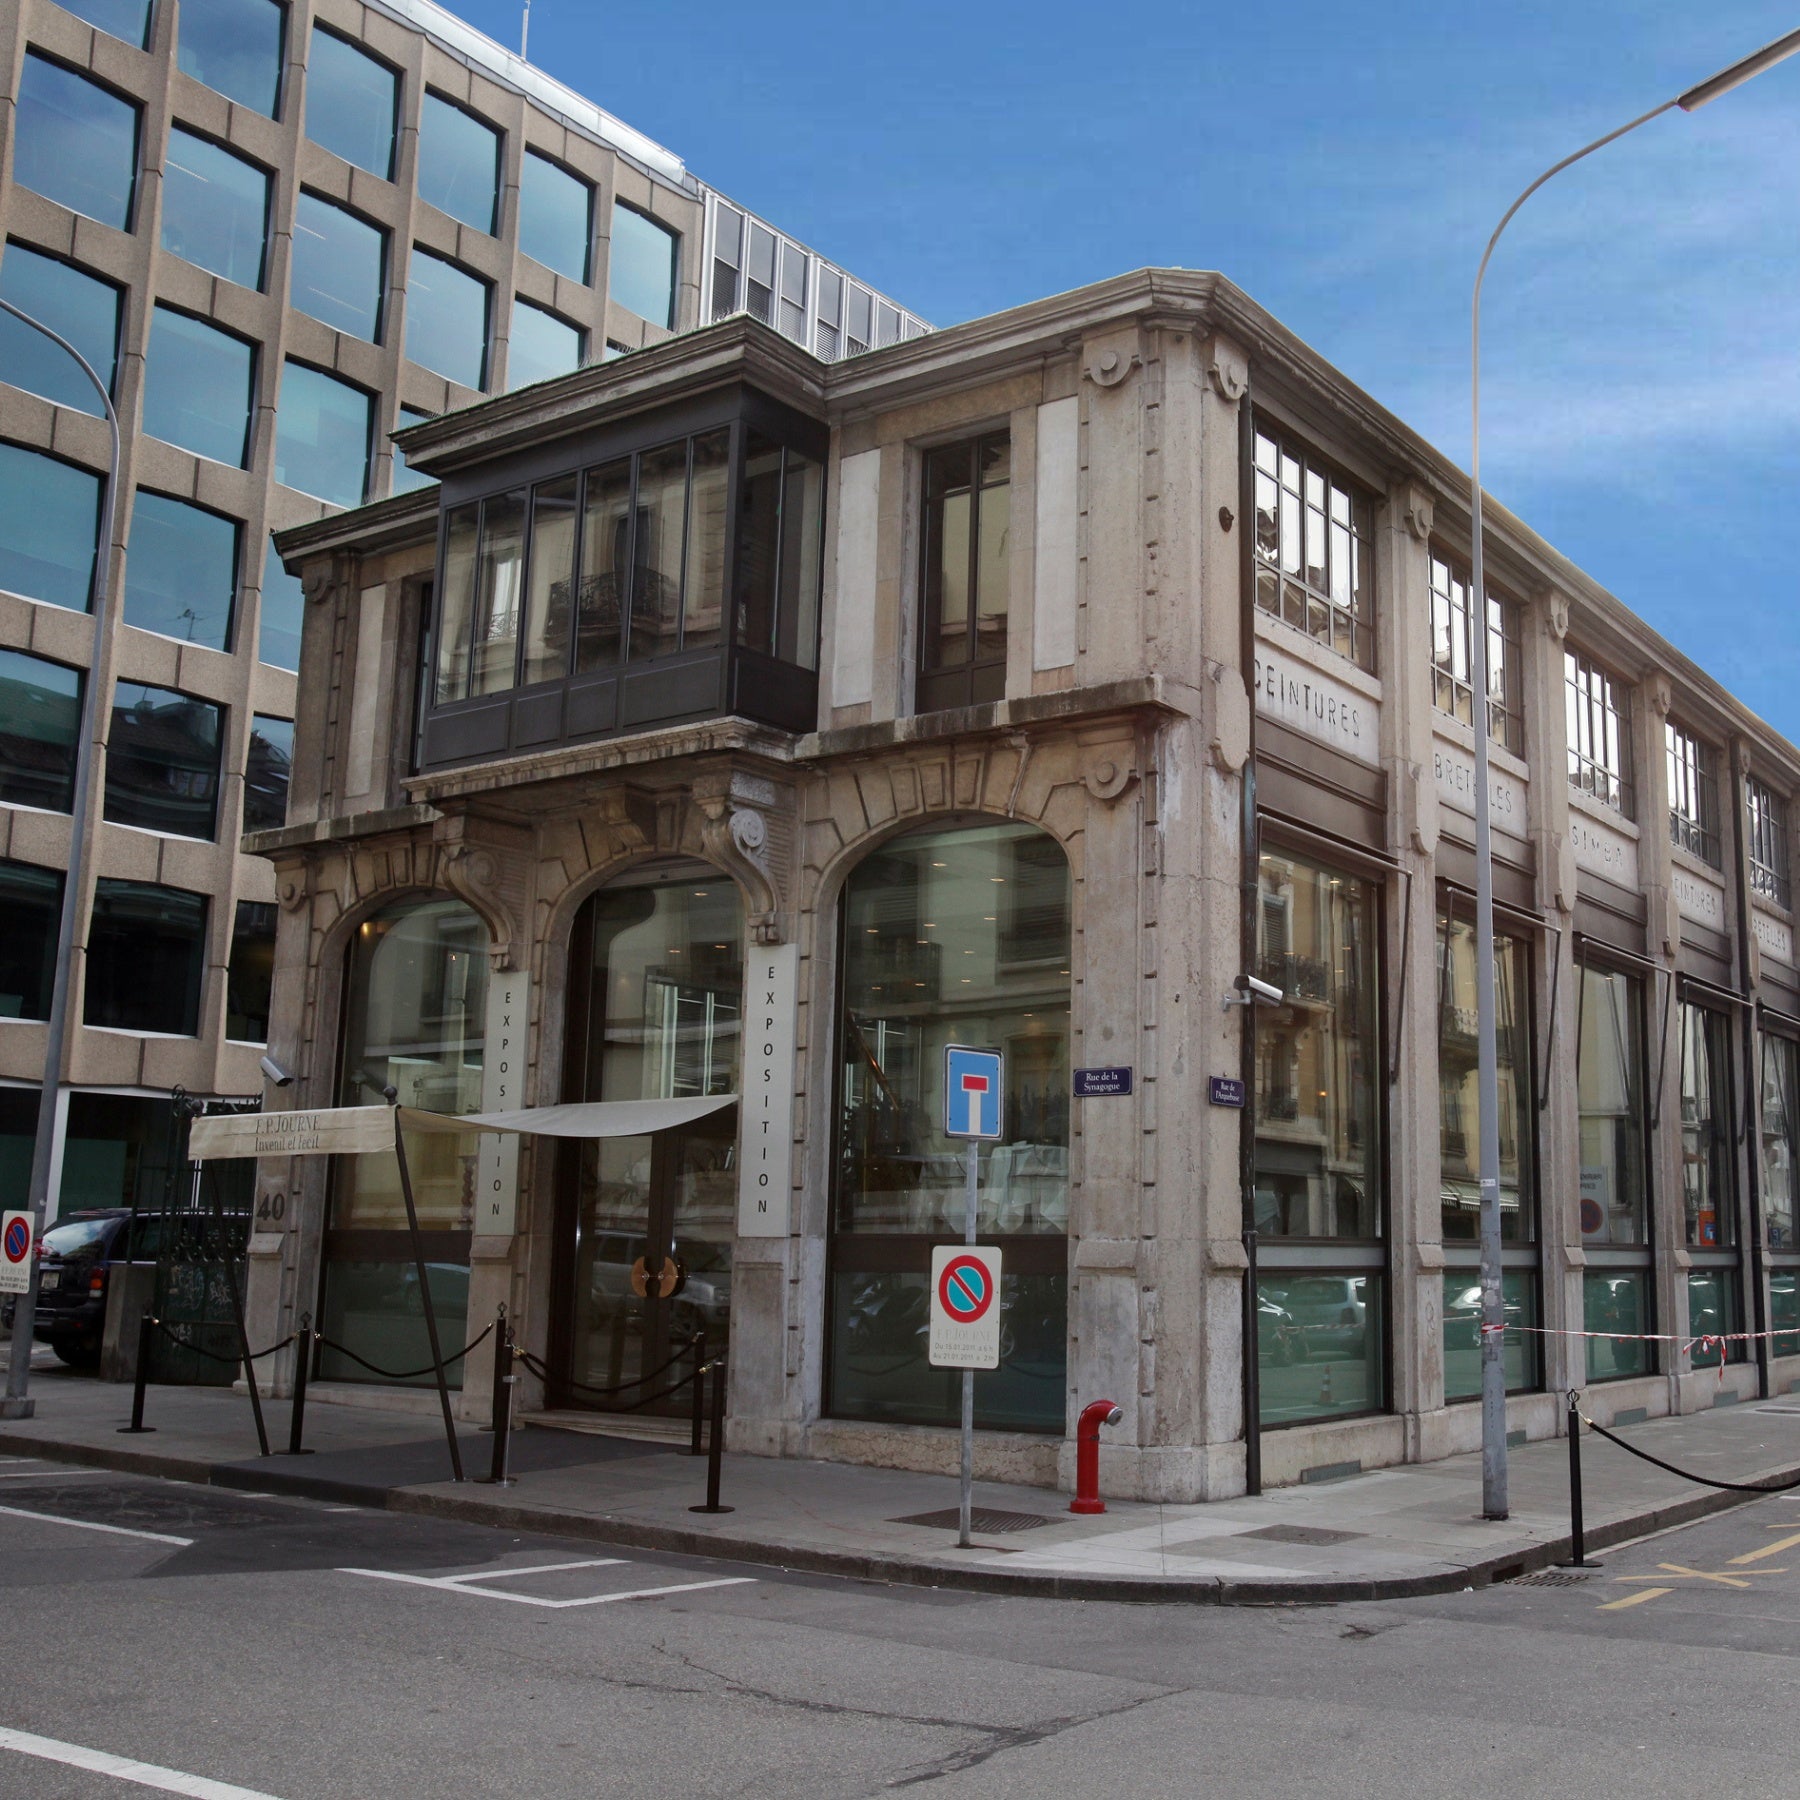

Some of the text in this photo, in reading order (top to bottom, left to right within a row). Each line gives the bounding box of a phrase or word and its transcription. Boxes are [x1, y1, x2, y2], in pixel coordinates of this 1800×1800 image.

[1434, 753, 1512, 813] BRETELES
[1673, 877, 1716, 916] EINTURES
[758, 966, 775, 1213] EXPOSITION
[1083, 1082, 1121, 1092] Synagogue
[1086, 1071, 1118, 1081] Rue de la
[491, 991, 511, 1215] EXPOSTION
[256, 1193, 285, 1221] 40
